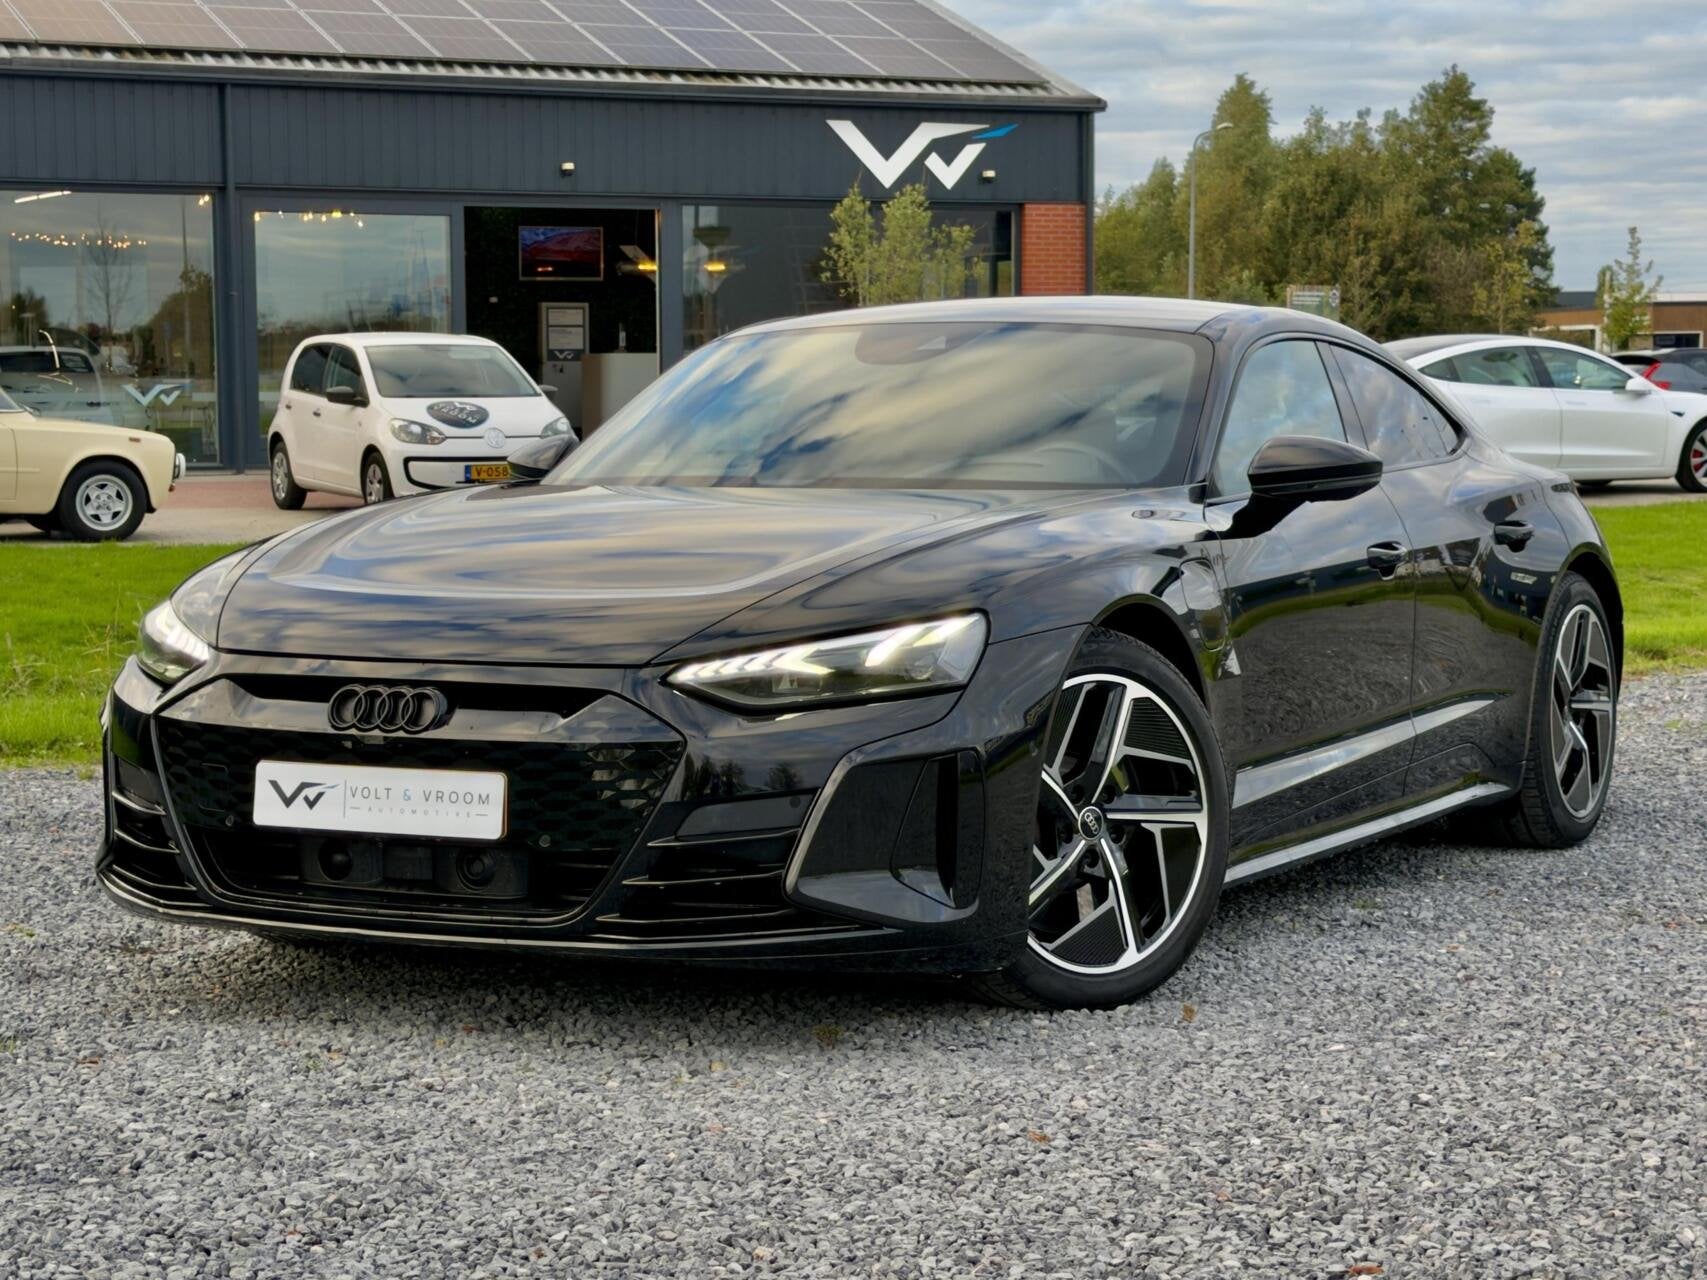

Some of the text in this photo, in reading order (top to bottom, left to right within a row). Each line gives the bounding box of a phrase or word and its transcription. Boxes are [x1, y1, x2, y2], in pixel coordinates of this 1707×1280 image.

[475, 465, 509, 478] V-058
[350, 785, 490, 806] VOLT & VROOM
[367, 805, 471, 819] AUTOMOTIVE
